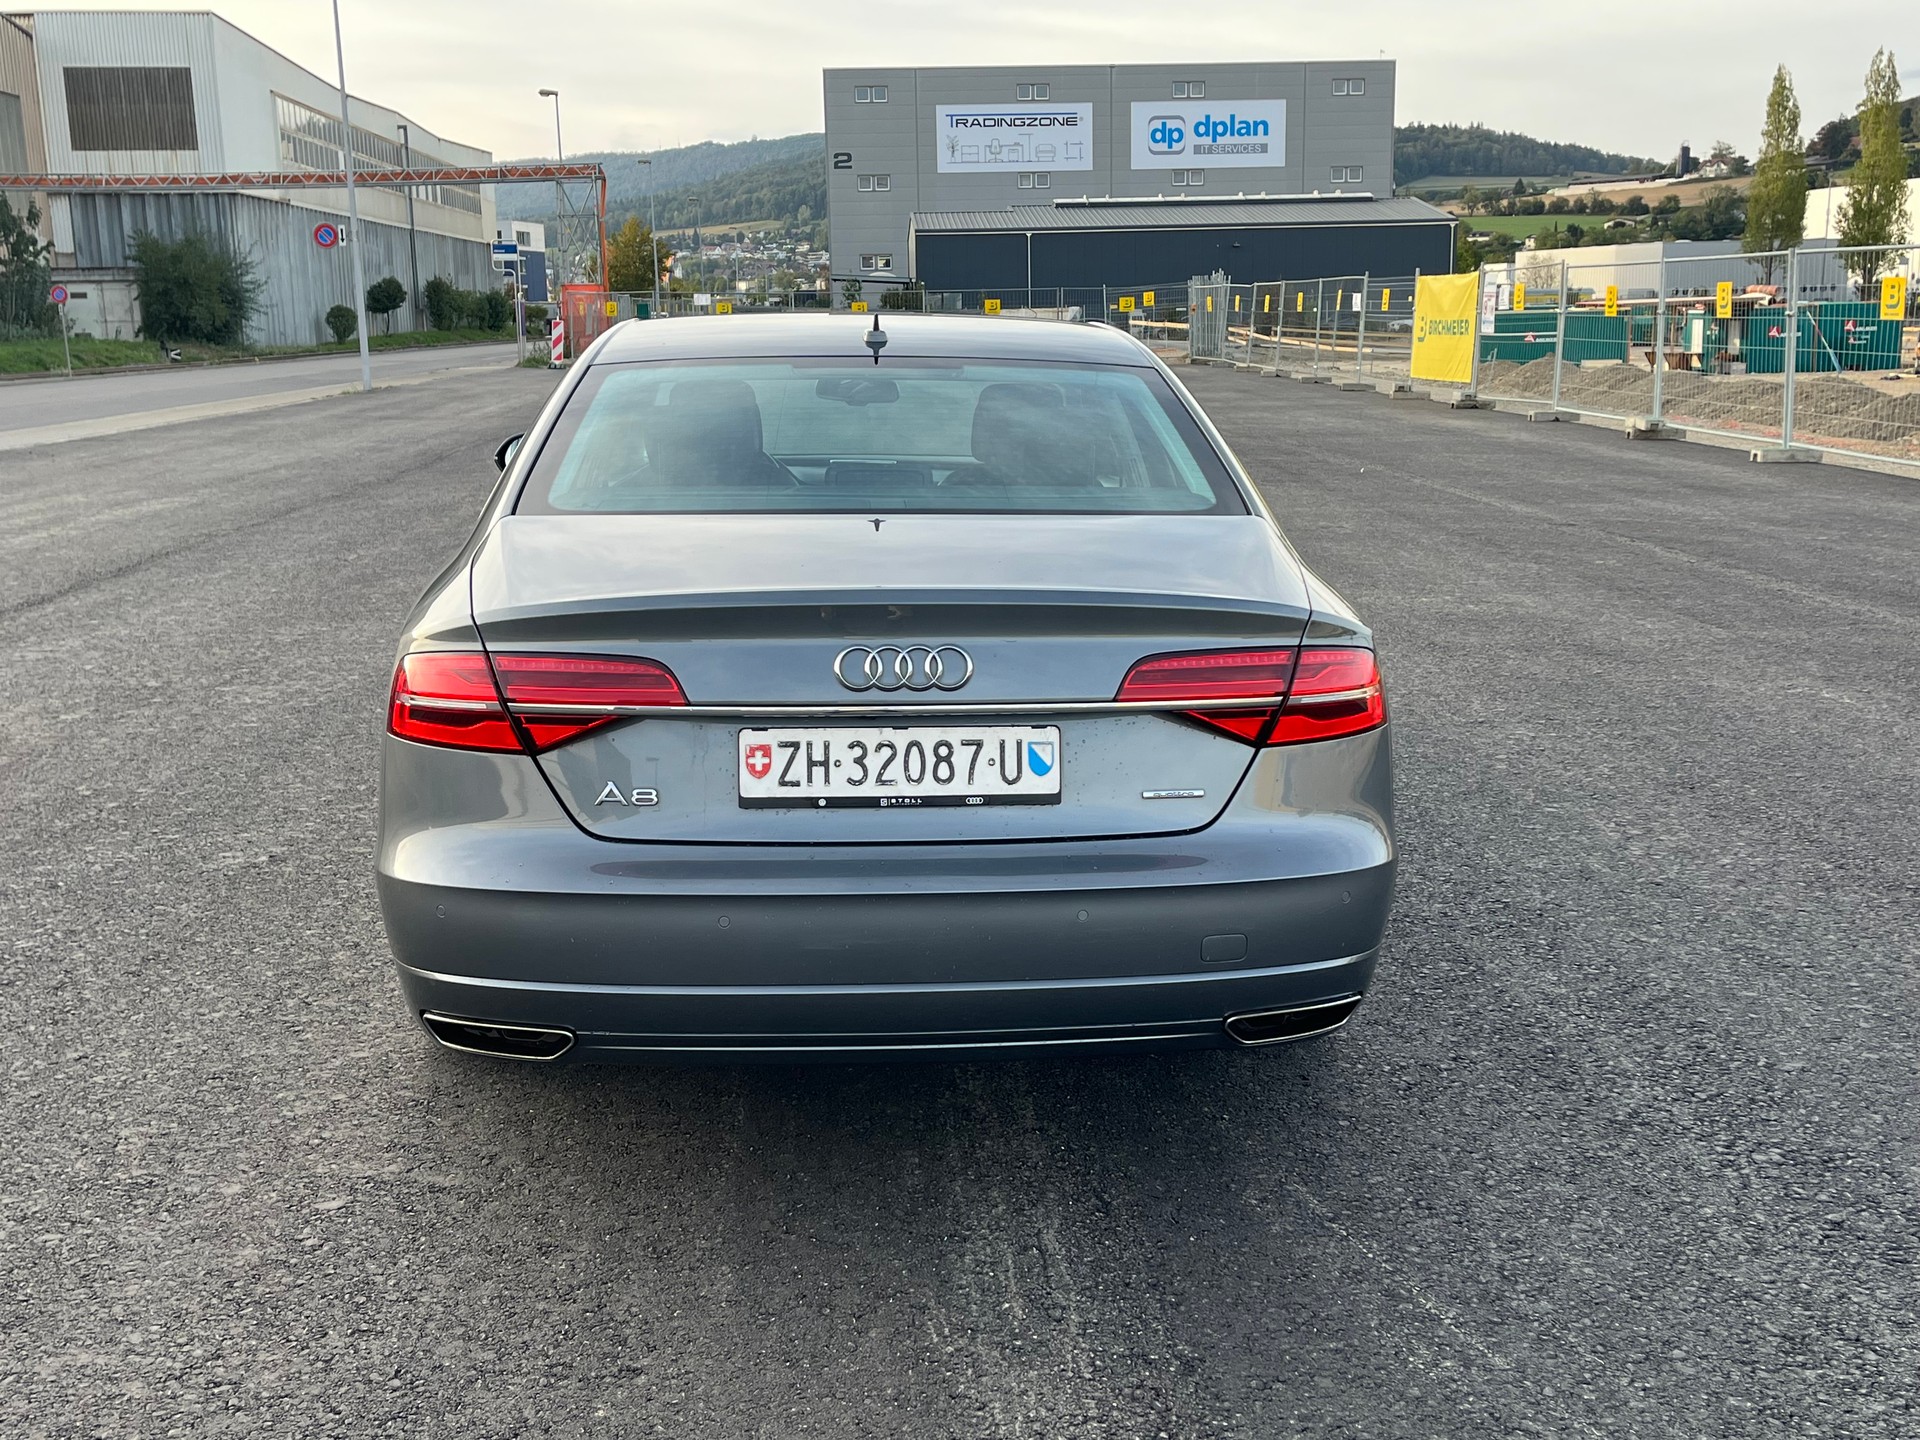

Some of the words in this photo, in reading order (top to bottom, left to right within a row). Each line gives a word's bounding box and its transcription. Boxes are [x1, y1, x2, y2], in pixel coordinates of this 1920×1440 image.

[1150, 121, 1184, 149] dp
[1193, 114, 1269, 143] dplan
[1200, 145, 1209, 154] IT
[1211, 144, 1262, 154] SERVICES
[833, 152, 853, 170] 2
[1428, 319, 1469, 336] BIRCHMEIER
[594, 780, 659, 807] A8
